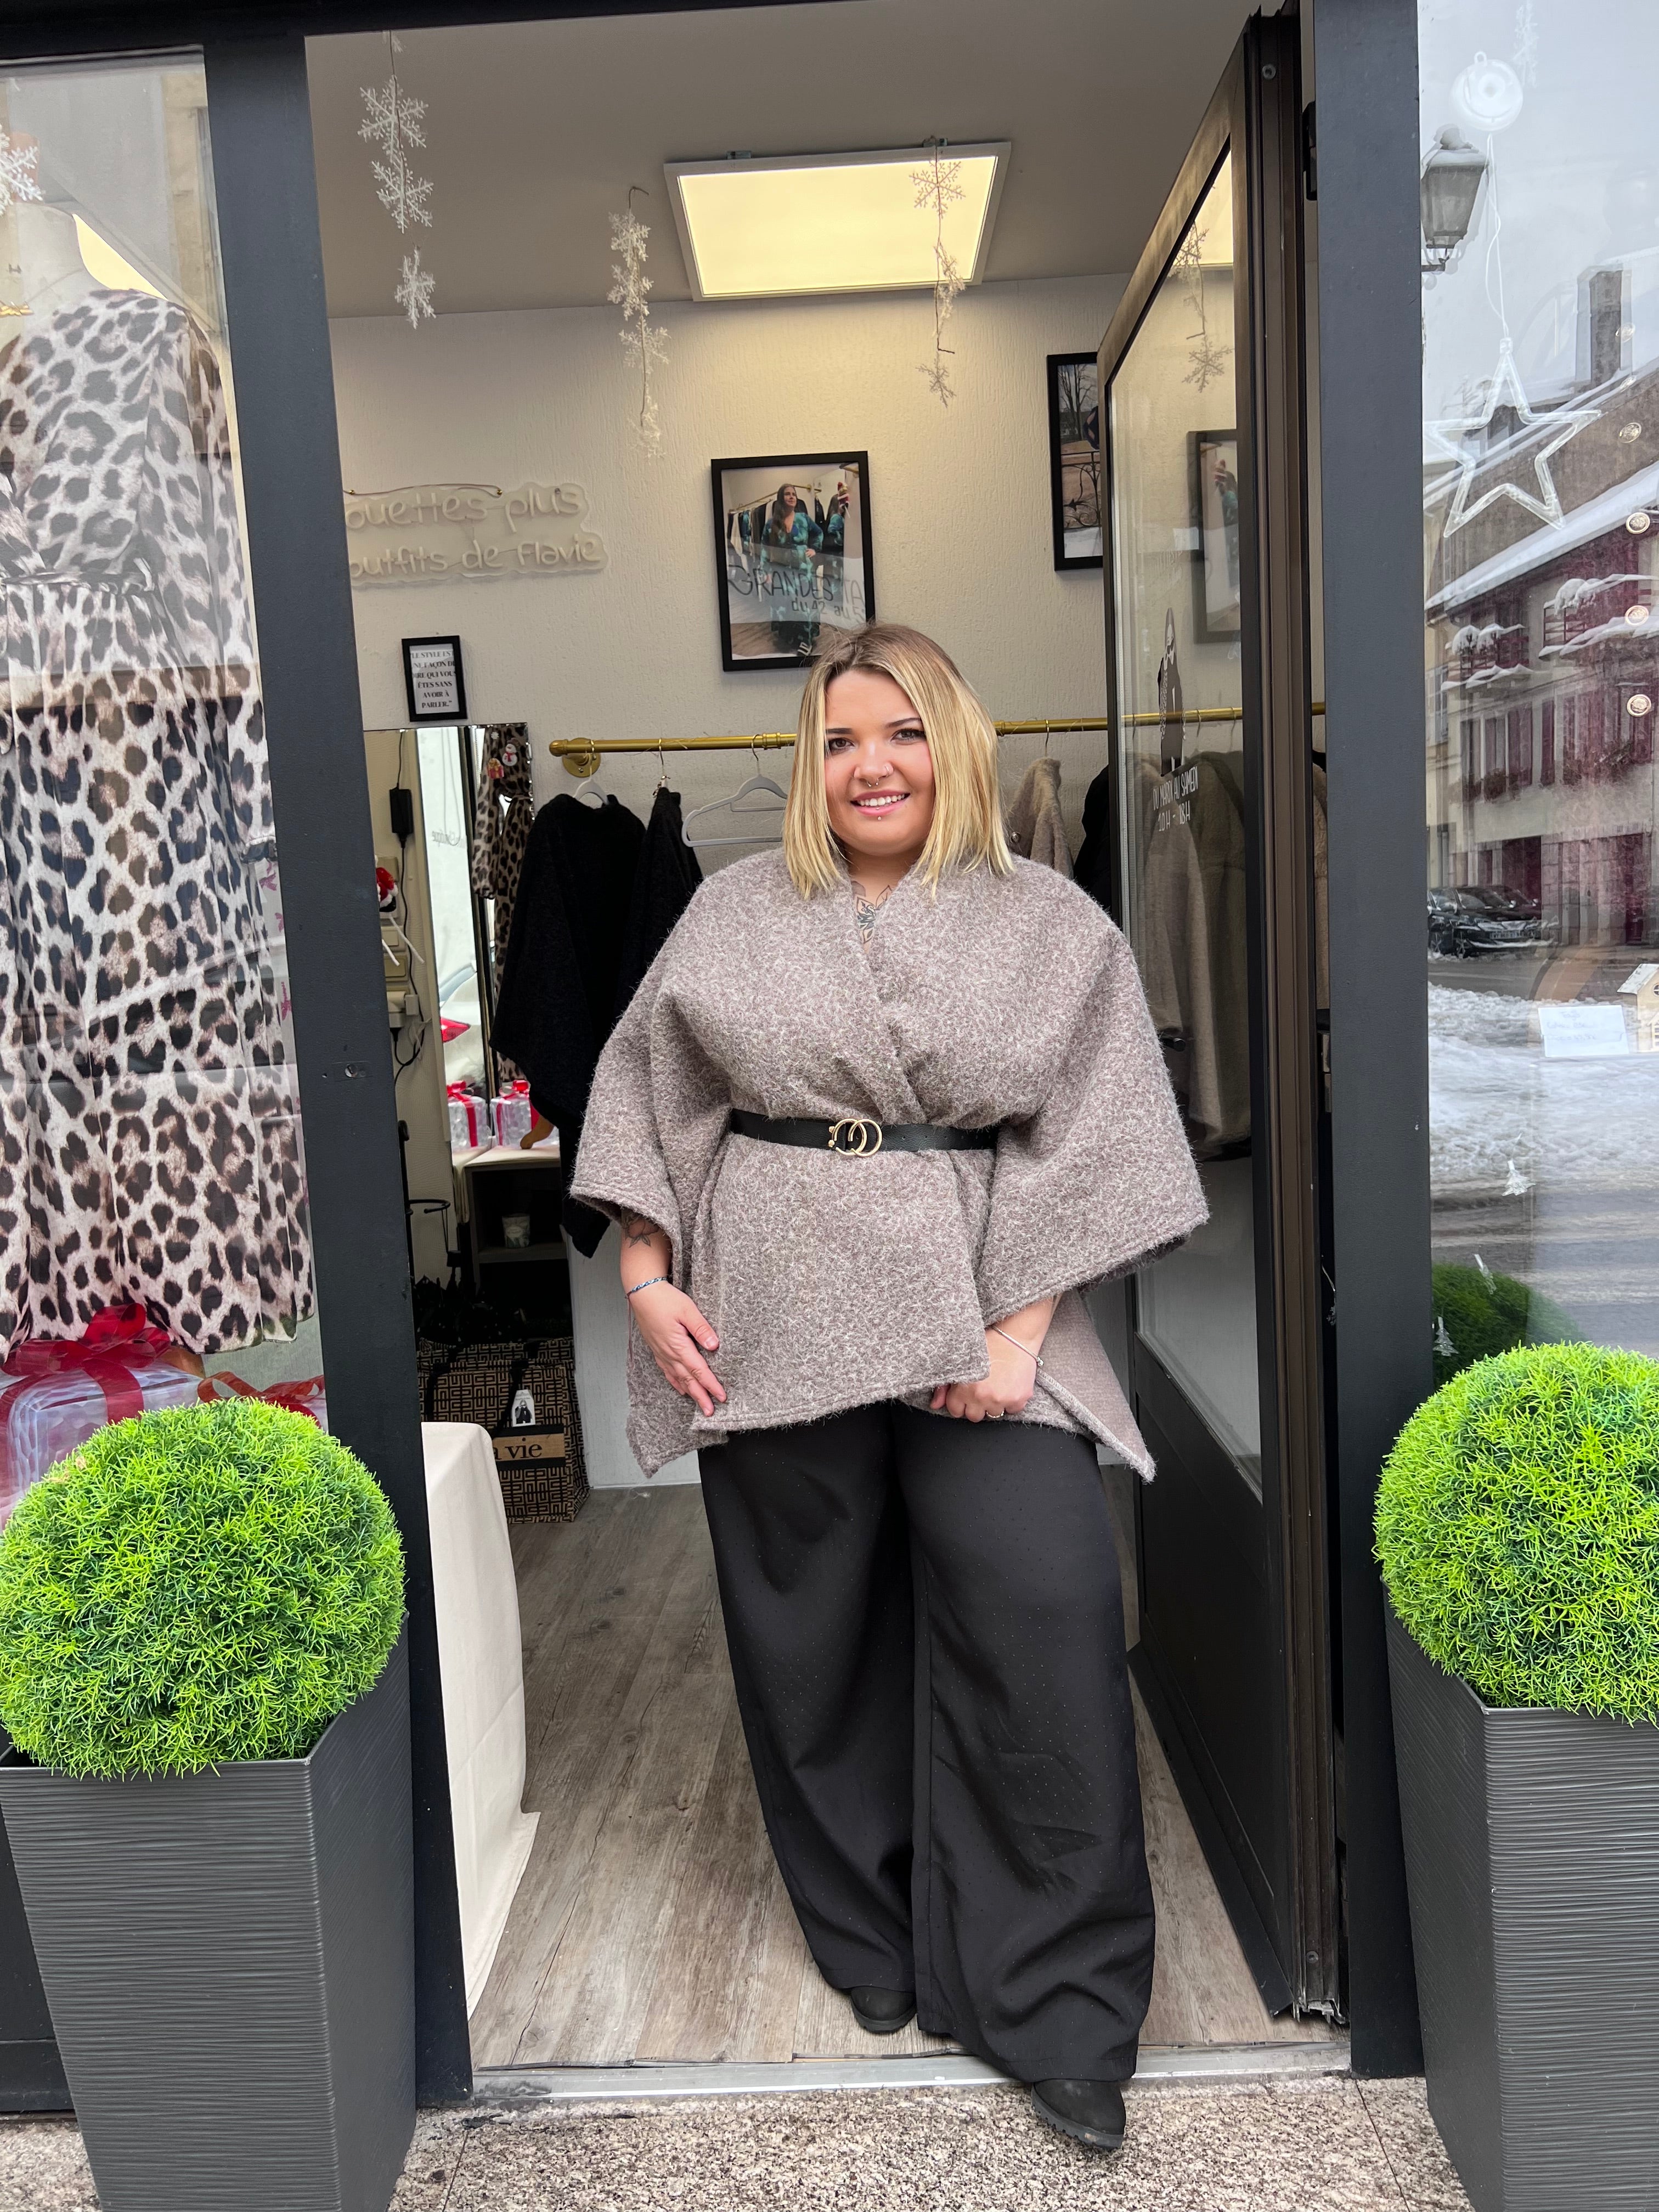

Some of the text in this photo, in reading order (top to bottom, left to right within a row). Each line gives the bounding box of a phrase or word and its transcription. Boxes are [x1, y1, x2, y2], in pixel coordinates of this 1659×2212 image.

[345, 488, 583, 533] ouettes plus
[348, 545, 448, 578] outfits
[462, 539, 503, 570] de
[727, 564, 834, 602] GRANDES
[792, 597, 808, 612] du
[812, 600, 827, 615] 42
[834, 605, 850, 619] au
[1153, 765, 1198, 811] DU MARDI AU SAMEDI
[504, 1437, 543, 1459] vie
